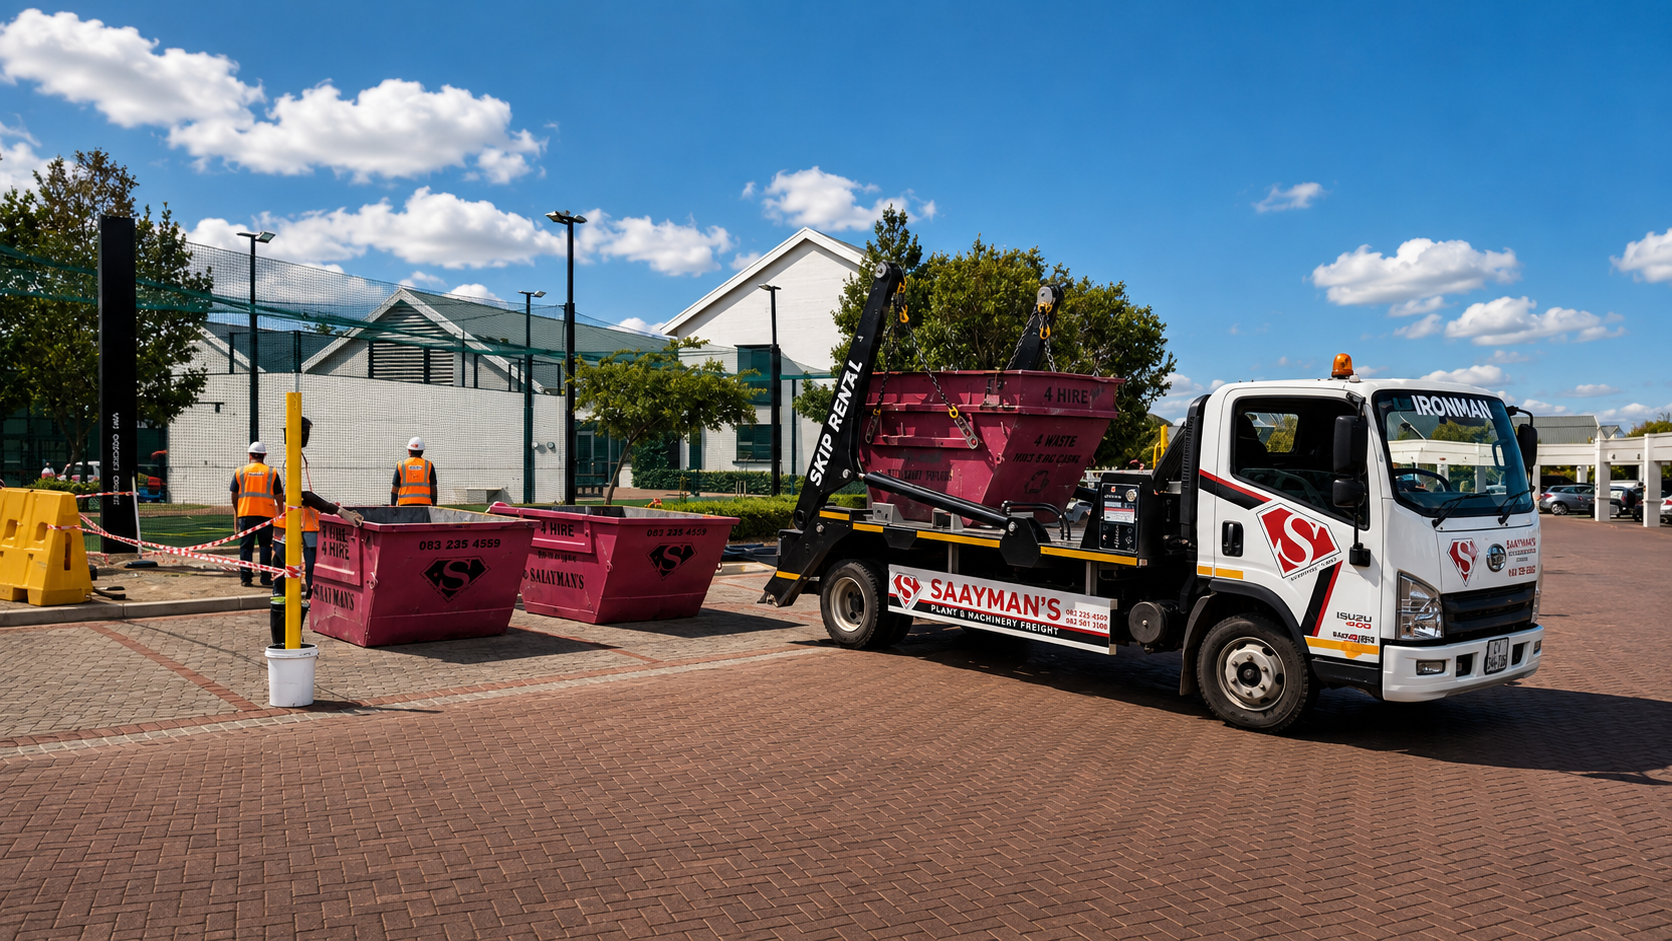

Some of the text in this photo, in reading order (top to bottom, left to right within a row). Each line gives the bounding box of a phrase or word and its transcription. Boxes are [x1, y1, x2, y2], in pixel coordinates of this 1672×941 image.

[1044, 387, 1053, 402] 4
[1057, 388, 1088, 404] HIRE
[1411, 395, 1493, 419] IRONMAN
[1034, 434, 1077, 447] 4 WASTE
[809, 433, 833, 486] SKIP
[550, 522, 574, 537] HIRE
[419, 539, 501, 550] 083 235 4559
[930, 578, 1061, 621] SAAYMAN'S
[931, 604, 957, 617] PLANT
[967, 611, 1018, 628] MACHINERY
[1020, 622, 1059, 635] FREIGHT
